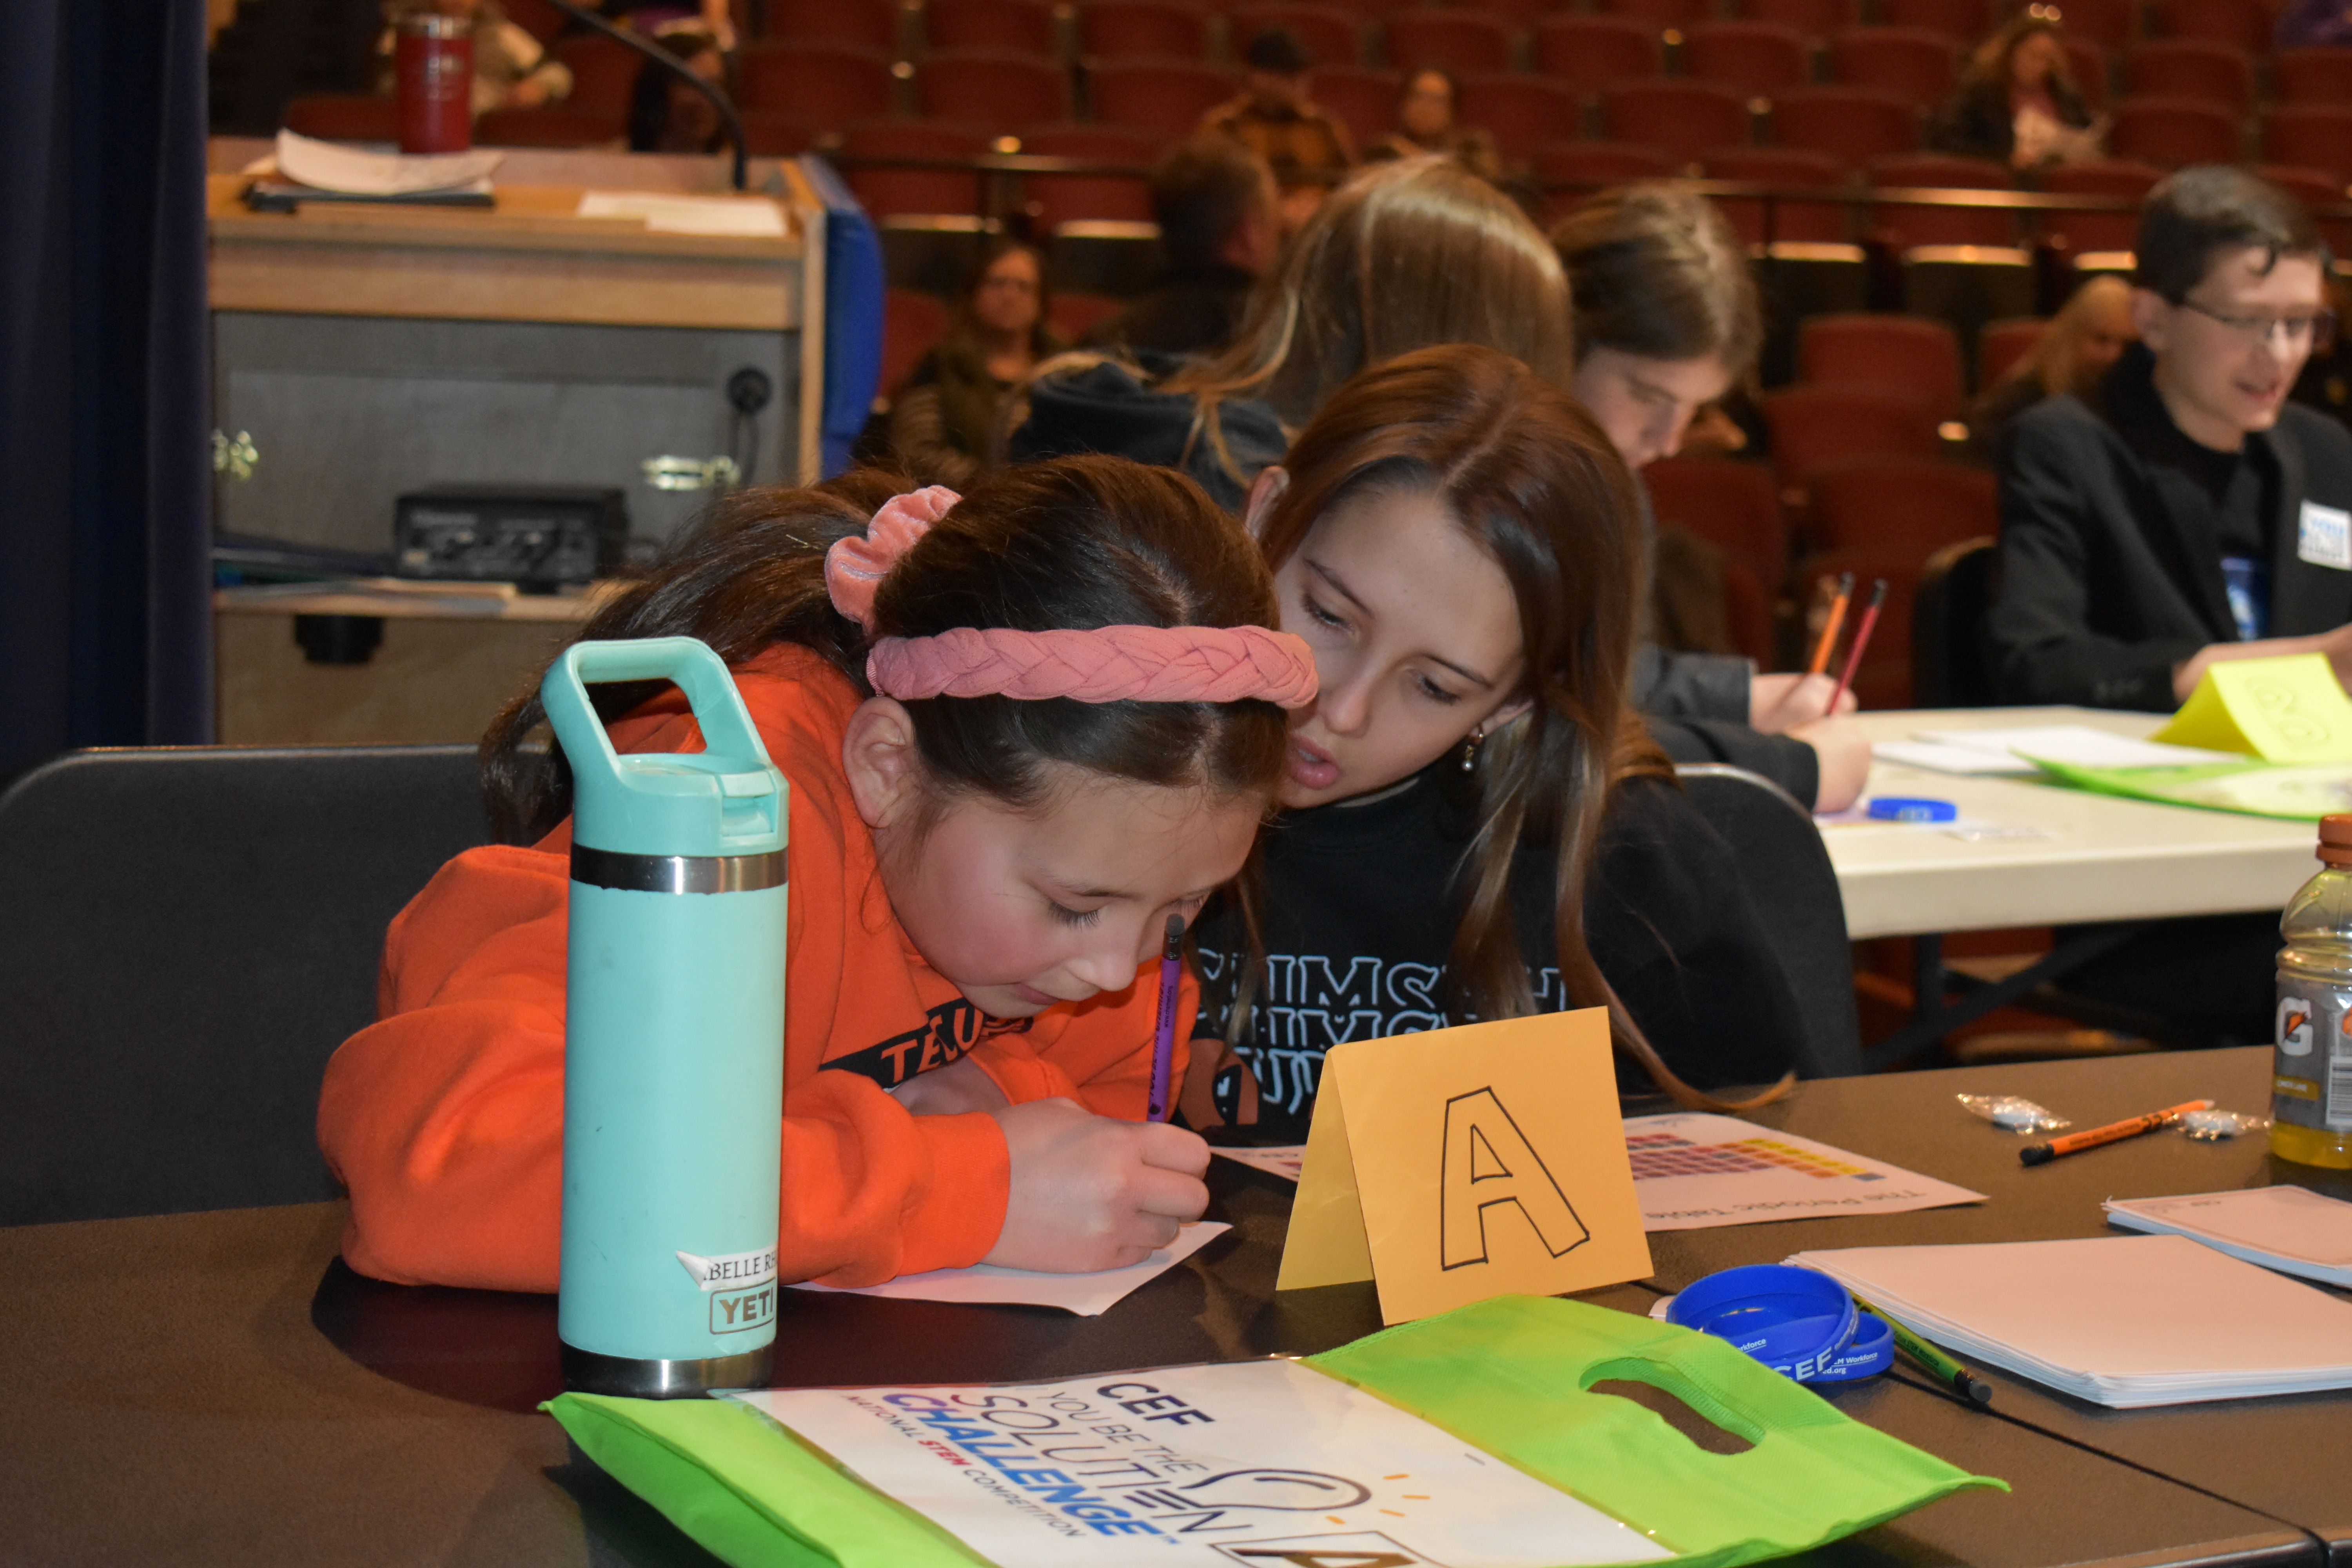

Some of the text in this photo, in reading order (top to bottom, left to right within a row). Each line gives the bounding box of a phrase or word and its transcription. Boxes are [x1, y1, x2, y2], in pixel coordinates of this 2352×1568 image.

[1441, 1085, 1590, 1271] A
[704, 1257, 761, 1281] BELLE
[719, 1287, 774, 1325] YETI
[1738, 1338, 1767, 1352] orkforce
[1846, 1352, 1878, 1364] Workforce
[1097, 1383, 1216, 1425] CEF
[1036, 1392, 1210, 1473] YOU BE THE
[841, 1395, 1087, 1537] NATIONAL STEM COMPETITION
